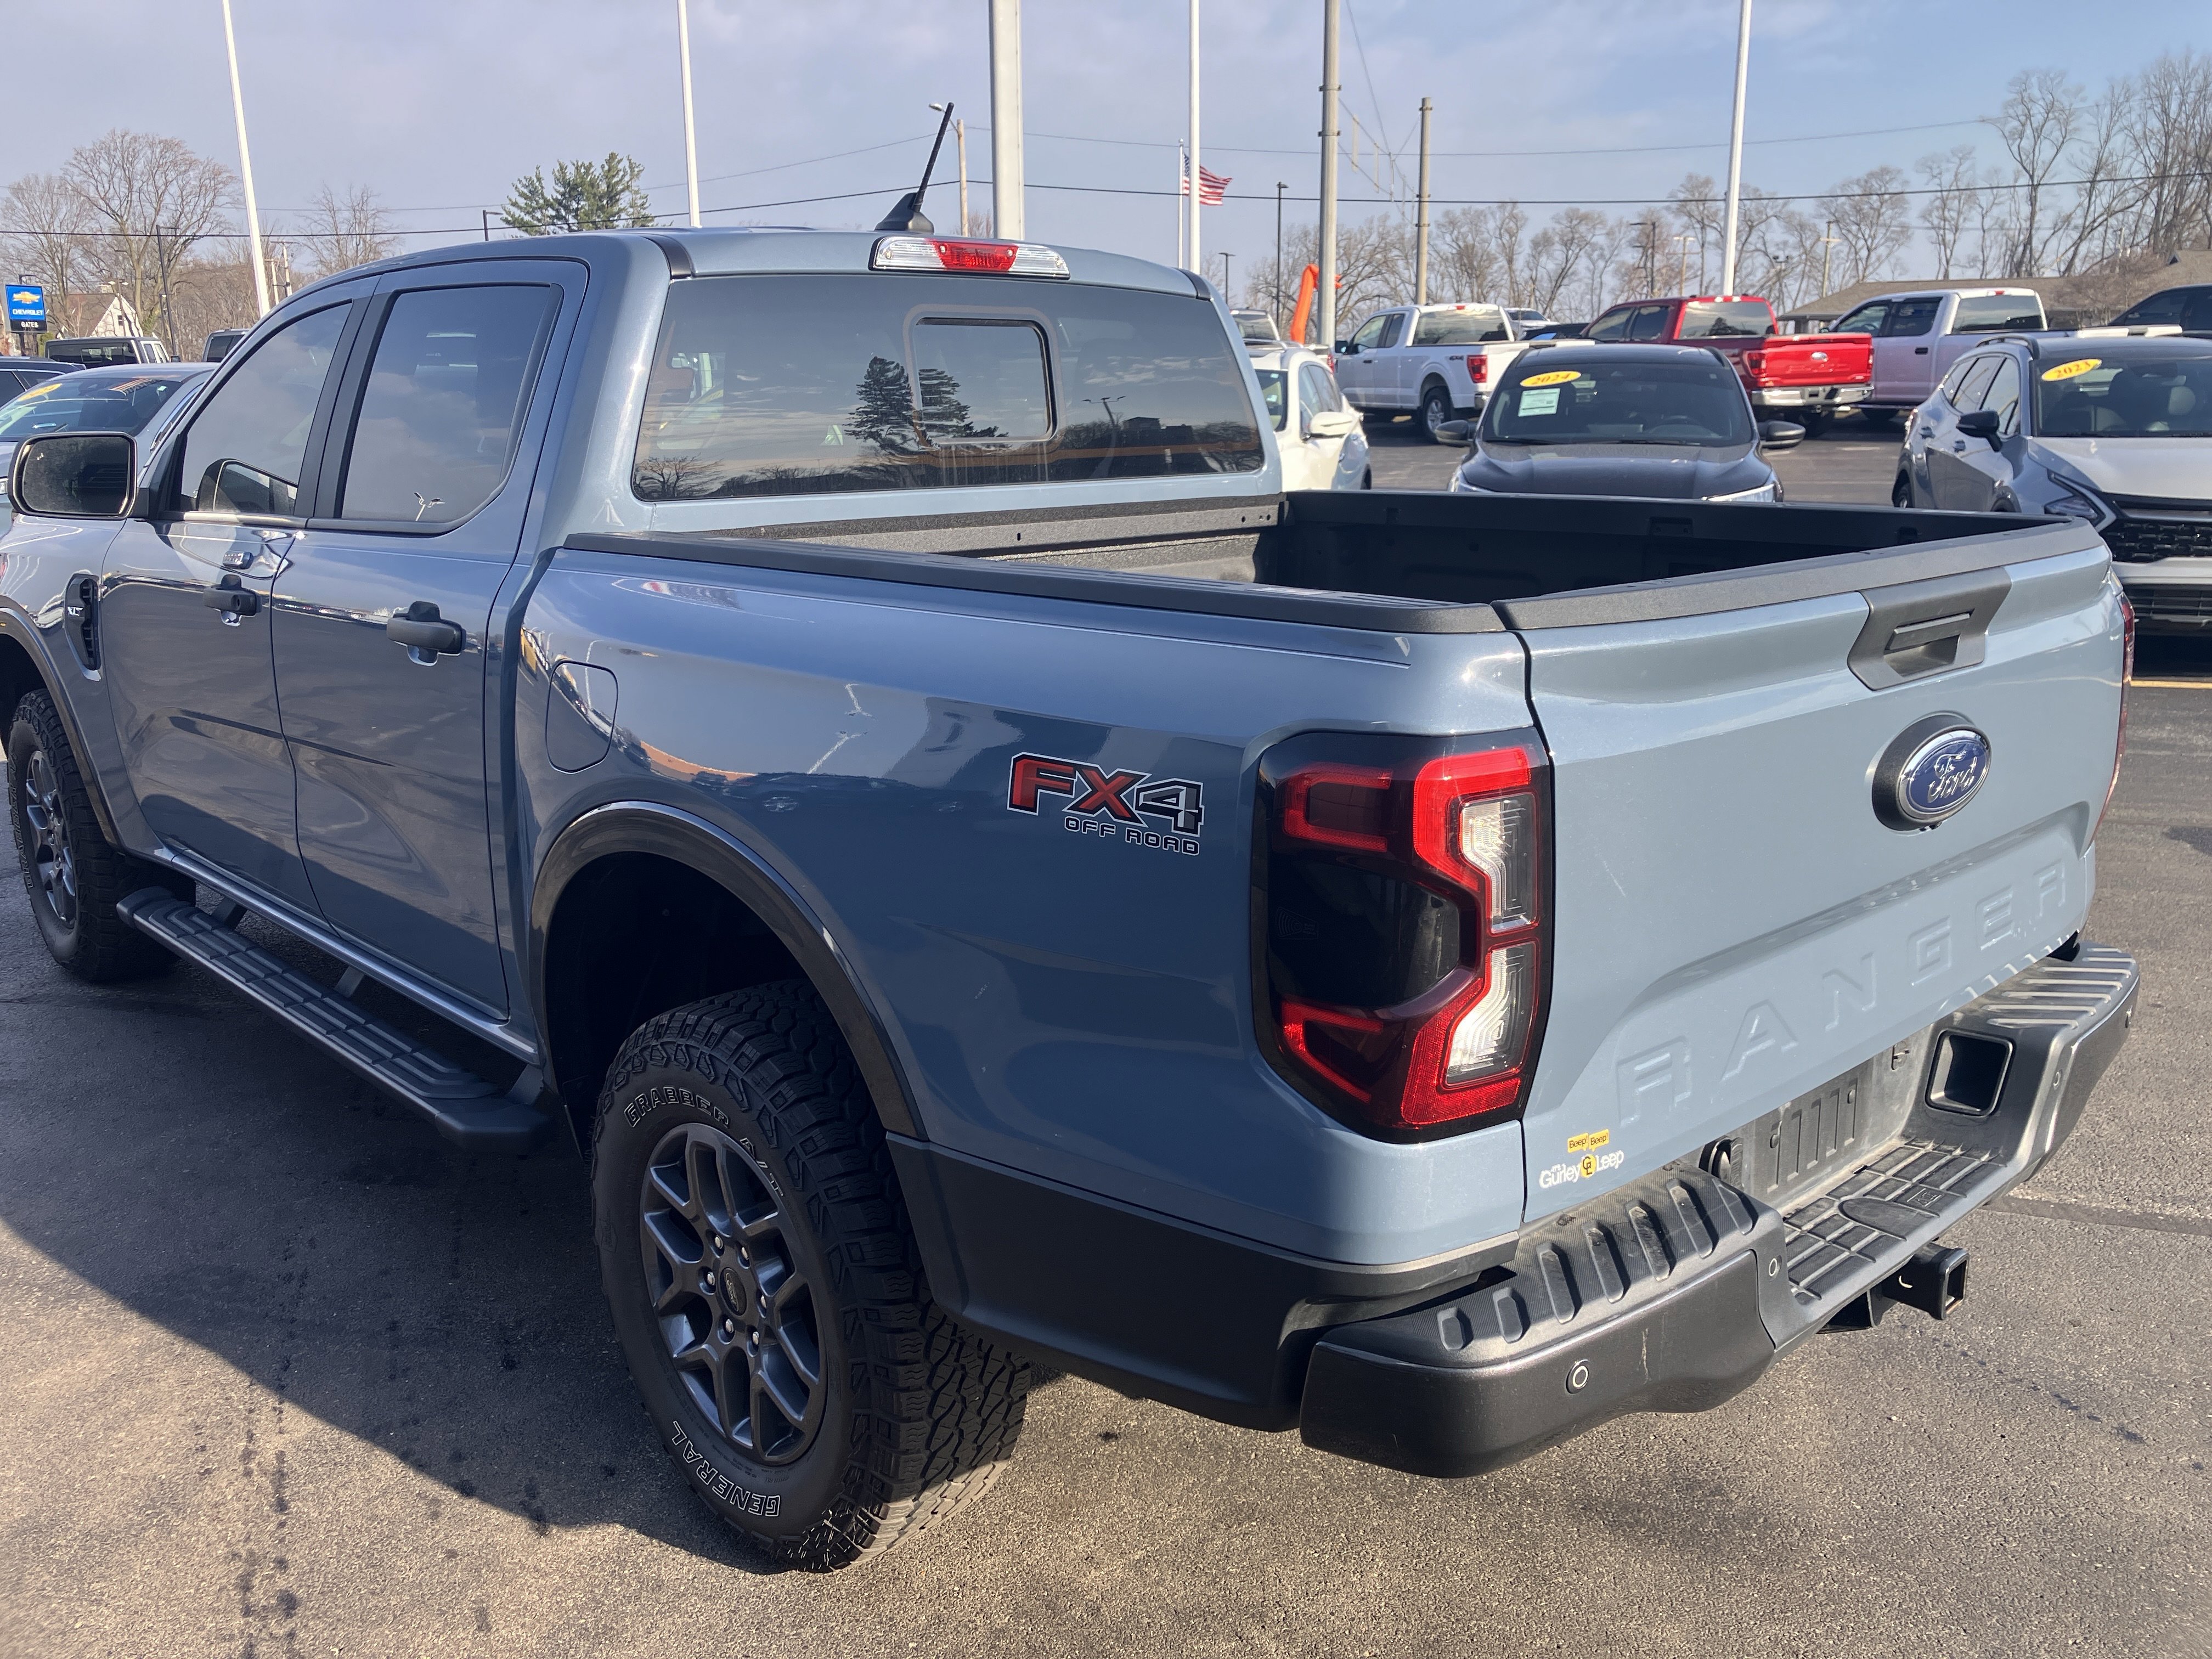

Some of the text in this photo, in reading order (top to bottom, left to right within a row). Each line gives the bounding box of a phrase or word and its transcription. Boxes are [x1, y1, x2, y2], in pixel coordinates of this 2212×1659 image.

[1531, 373, 1572, 385] 2024
[67, 606, 83, 616] XLT
[1007, 752, 1205, 838] FX4
[1927, 750, 1978, 804] Ford
[1064, 816, 1200, 856] OFF ROAD
[1617, 859, 2067, 1128] RANGER
[624, 1086, 730, 1128] GRABBER
[1569, 1132, 1608, 1148] Beep! Beep!
[1539, 1163, 1581, 1188] Gurley
[1595, 1150, 1624, 1171] Leep
[672, 1420, 781, 1517] GENERAL
